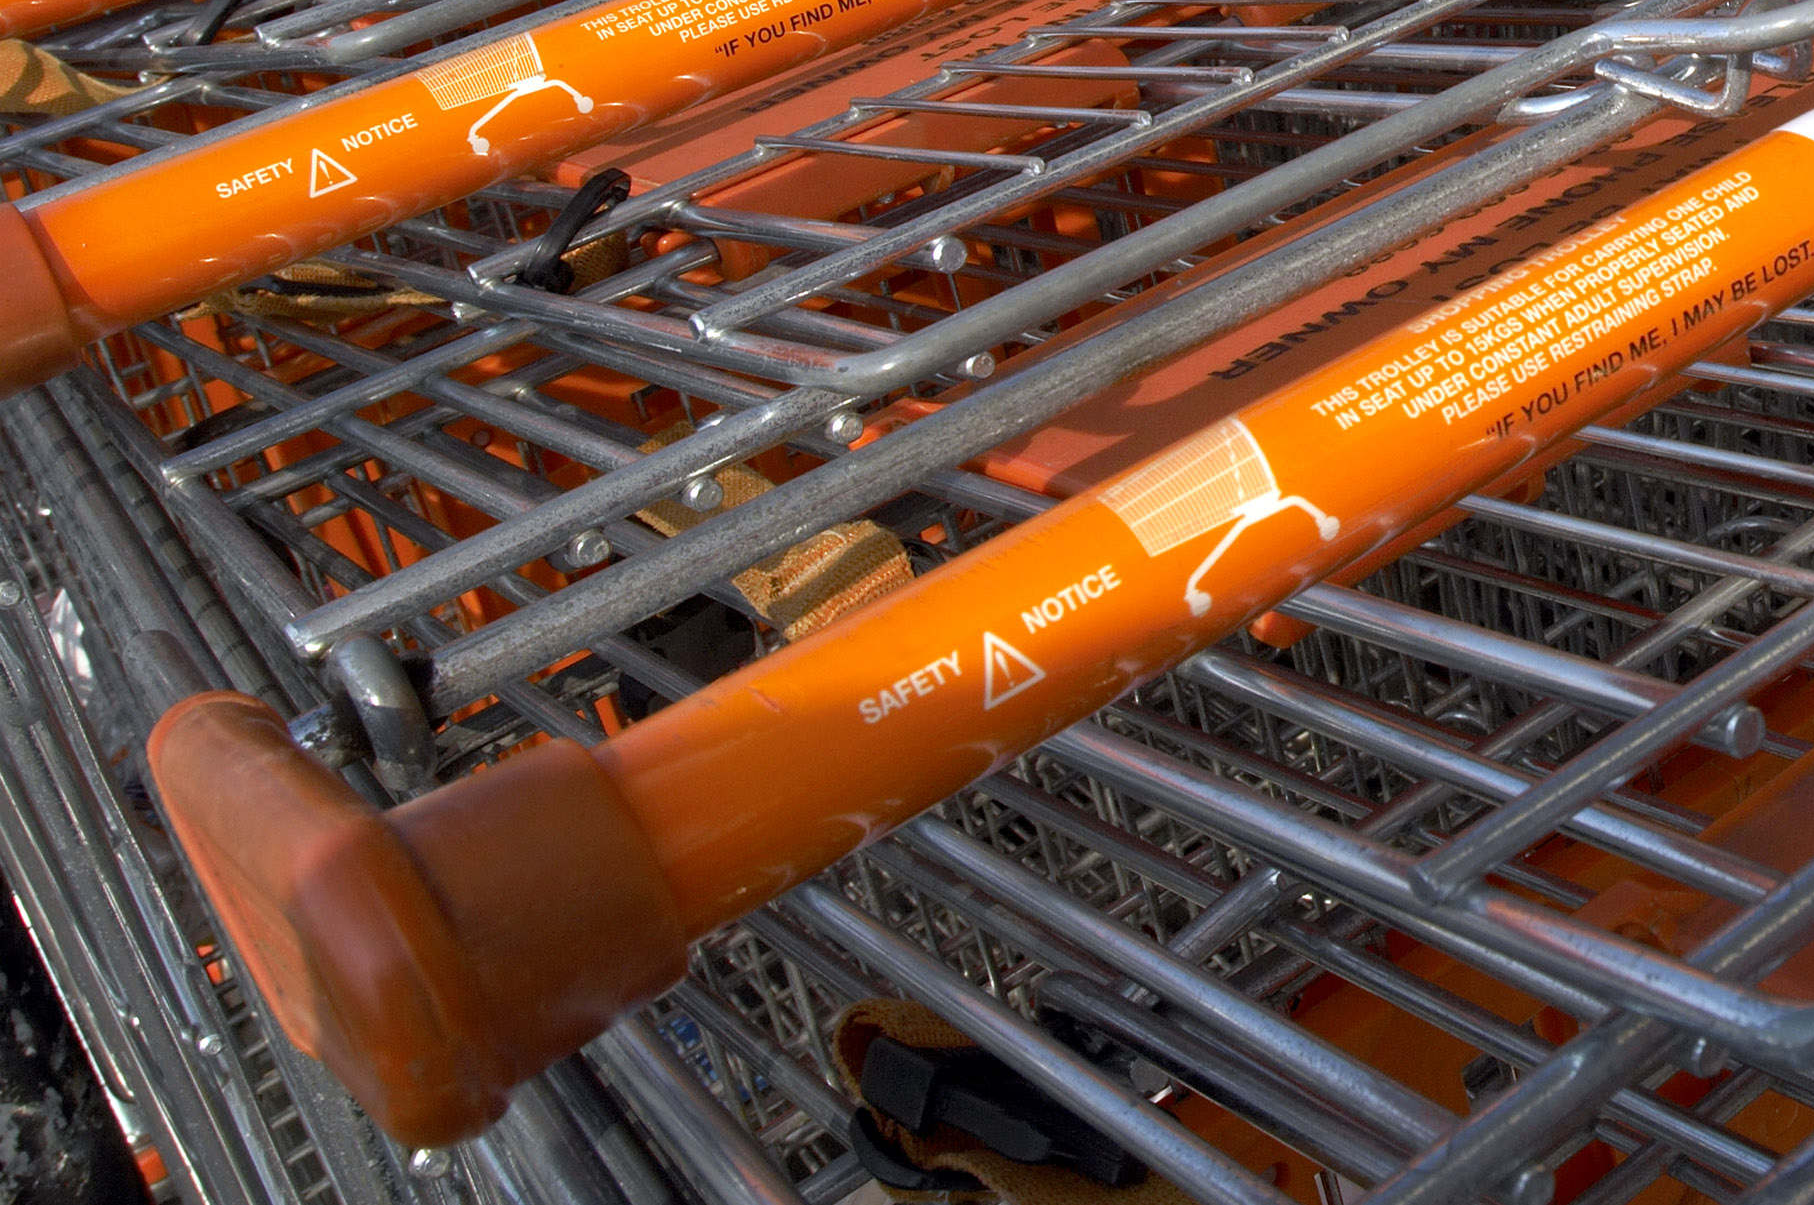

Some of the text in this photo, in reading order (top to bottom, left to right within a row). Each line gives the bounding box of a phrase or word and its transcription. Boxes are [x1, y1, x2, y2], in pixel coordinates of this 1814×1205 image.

[649, 8, 703, 36] UNDER
[679, 11, 737, 42] PLEASE
[738, 0, 769, 19] USE
[744, 21, 785, 47] YOU
[790, 3, 833, 30] FIND
[216, 113, 417, 198] SAFETY NOTICE
[1311, 171, 1751, 415] THIS TROLLEY IS SUITABLE FOR CARRYING ONE CHILD
[1335, 186, 1758, 429] IN SEAT UP TO 15KGS WHEN PROPERLY SEATED AND
[1421, 236, 1499, 275] MY
[1208, 280, 1408, 380] OWNER
[1403, 228, 1728, 417] UNDER CONSTANT ADULT SUPERVISION.
[1442, 257, 1716, 423] PLEASE USE RESTRAINING STRAP.
[1521, 383, 1568, 422] YOU
[1574, 351, 1623, 393] FIND
[1629, 328, 1666, 360] ME,
[1672, 318, 1678, 336] I
[1683, 290, 1723, 331] MAY
[1731, 272, 1757, 301] BE
[1762, 240, 1814, 283] LOST.
[859, 565, 1119, 722] SAFETY NOTICE
